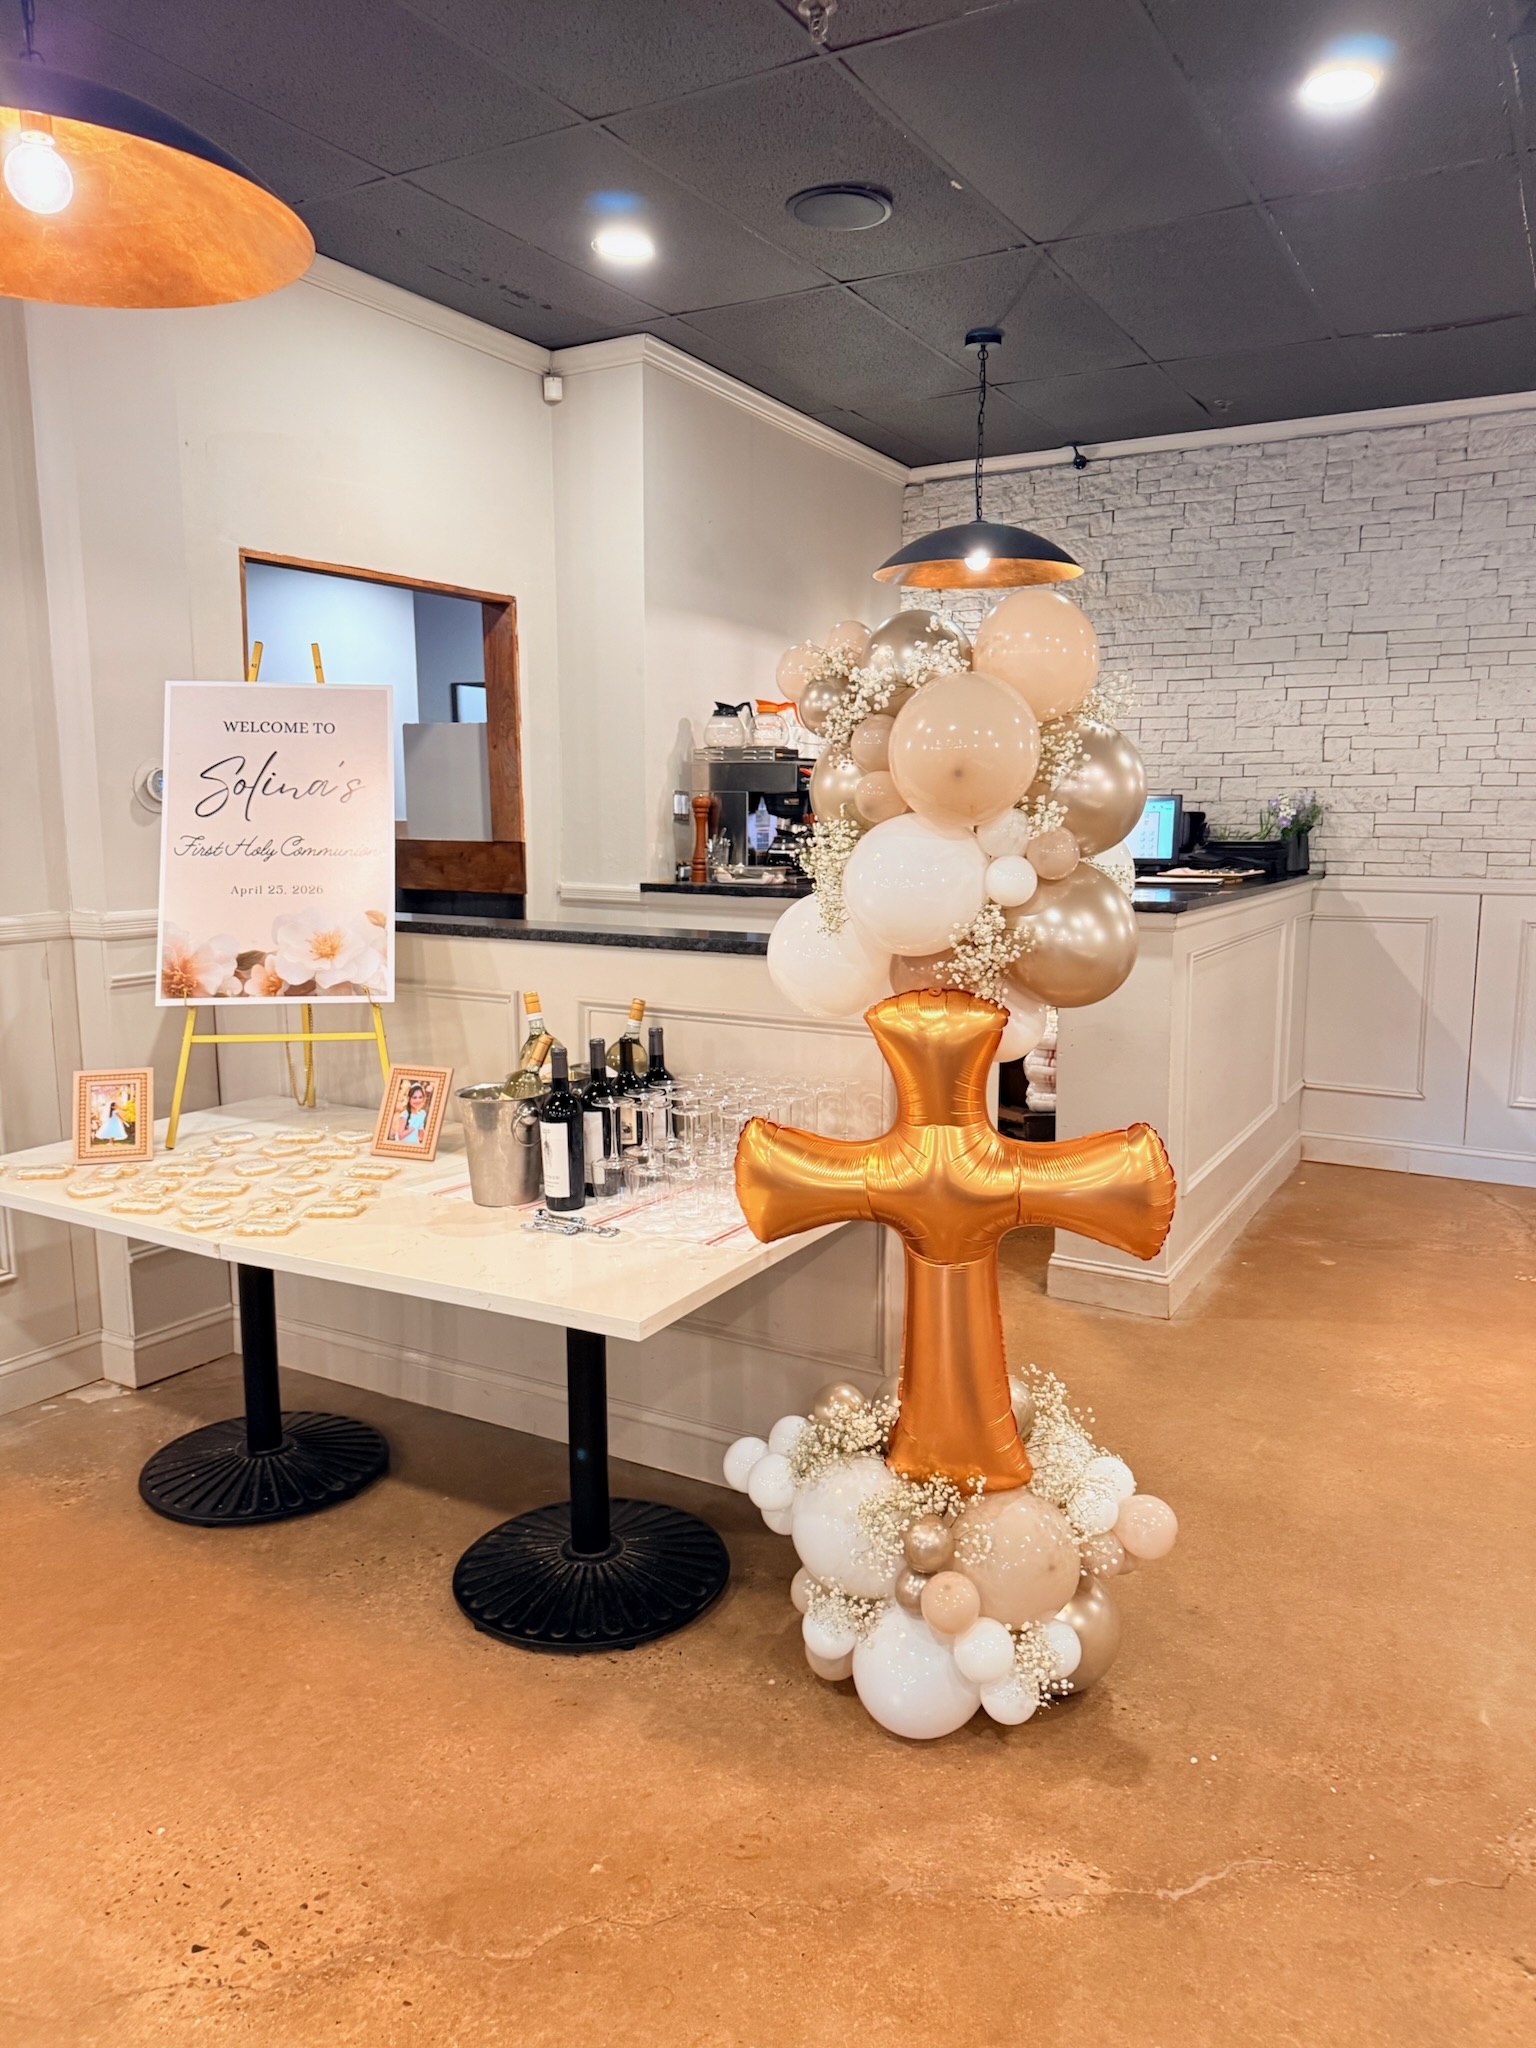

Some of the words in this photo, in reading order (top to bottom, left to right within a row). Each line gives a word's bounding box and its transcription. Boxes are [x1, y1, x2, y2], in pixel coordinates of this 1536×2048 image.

[222, 720, 309, 734] WELCOME
[312, 722, 336, 735] TO
[195, 750, 366, 822] Solina's
[173, 834, 225, 857] First
[225, 834, 278, 862] Holy
[230, 884, 263, 897] April
[292, 884, 324, 896] 2026
